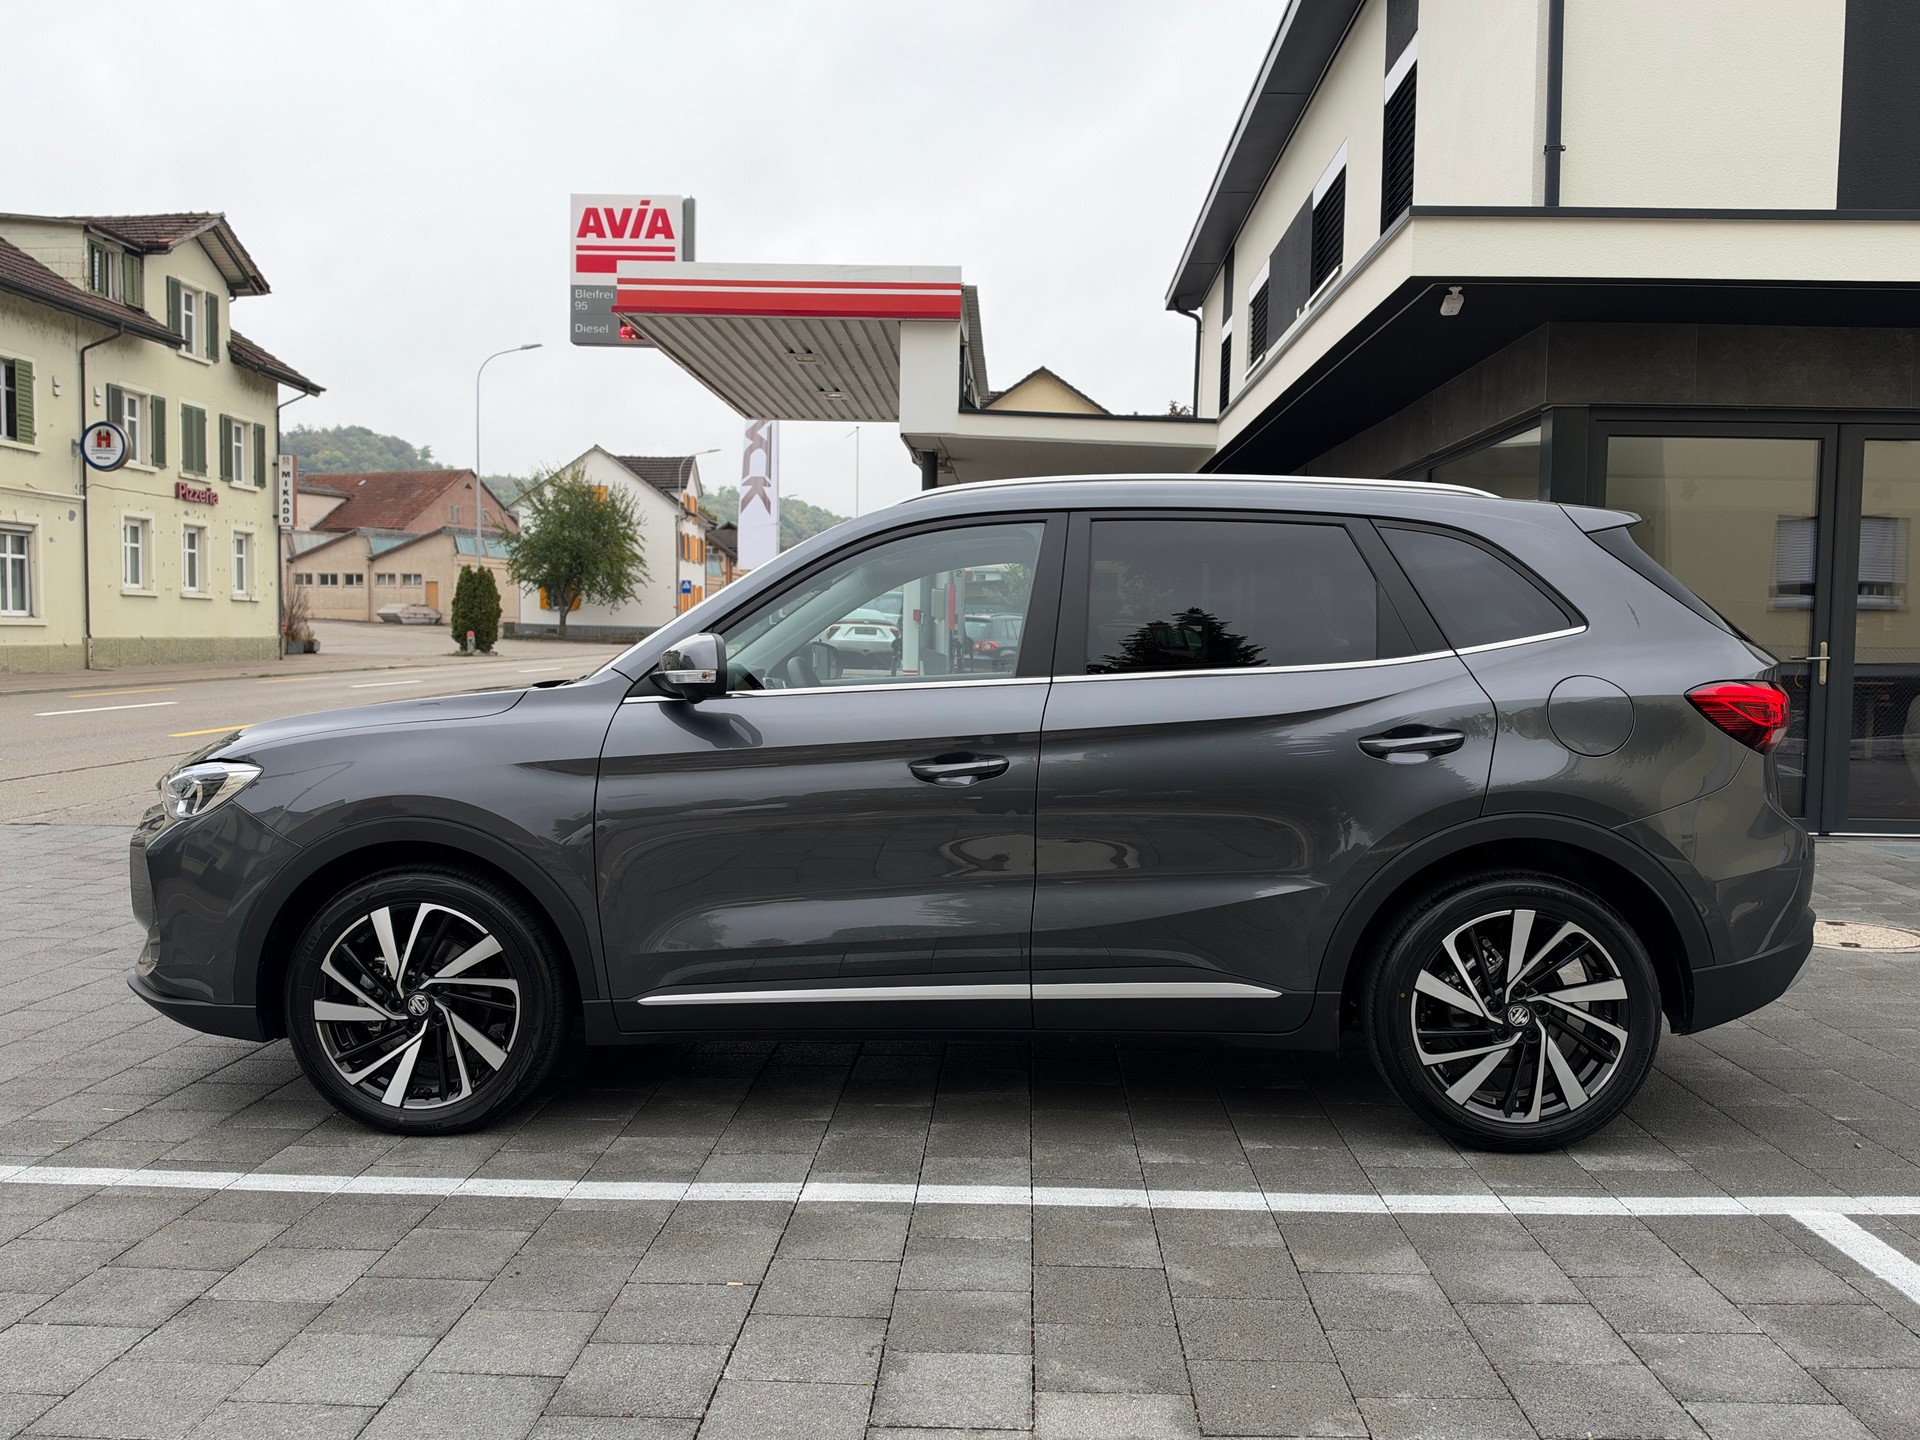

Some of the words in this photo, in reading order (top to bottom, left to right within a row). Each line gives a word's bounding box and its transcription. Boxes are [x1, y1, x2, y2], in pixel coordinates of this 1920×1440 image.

[575, 289, 614, 299] Bleifrei
[574, 301, 588, 311] 95
[575, 323, 609, 333] Diesel
[177, 482, 219, 505] Pizzeria
[282, 471, 291, 524] MIKADO
[409, 996, 428, 1015] MG
